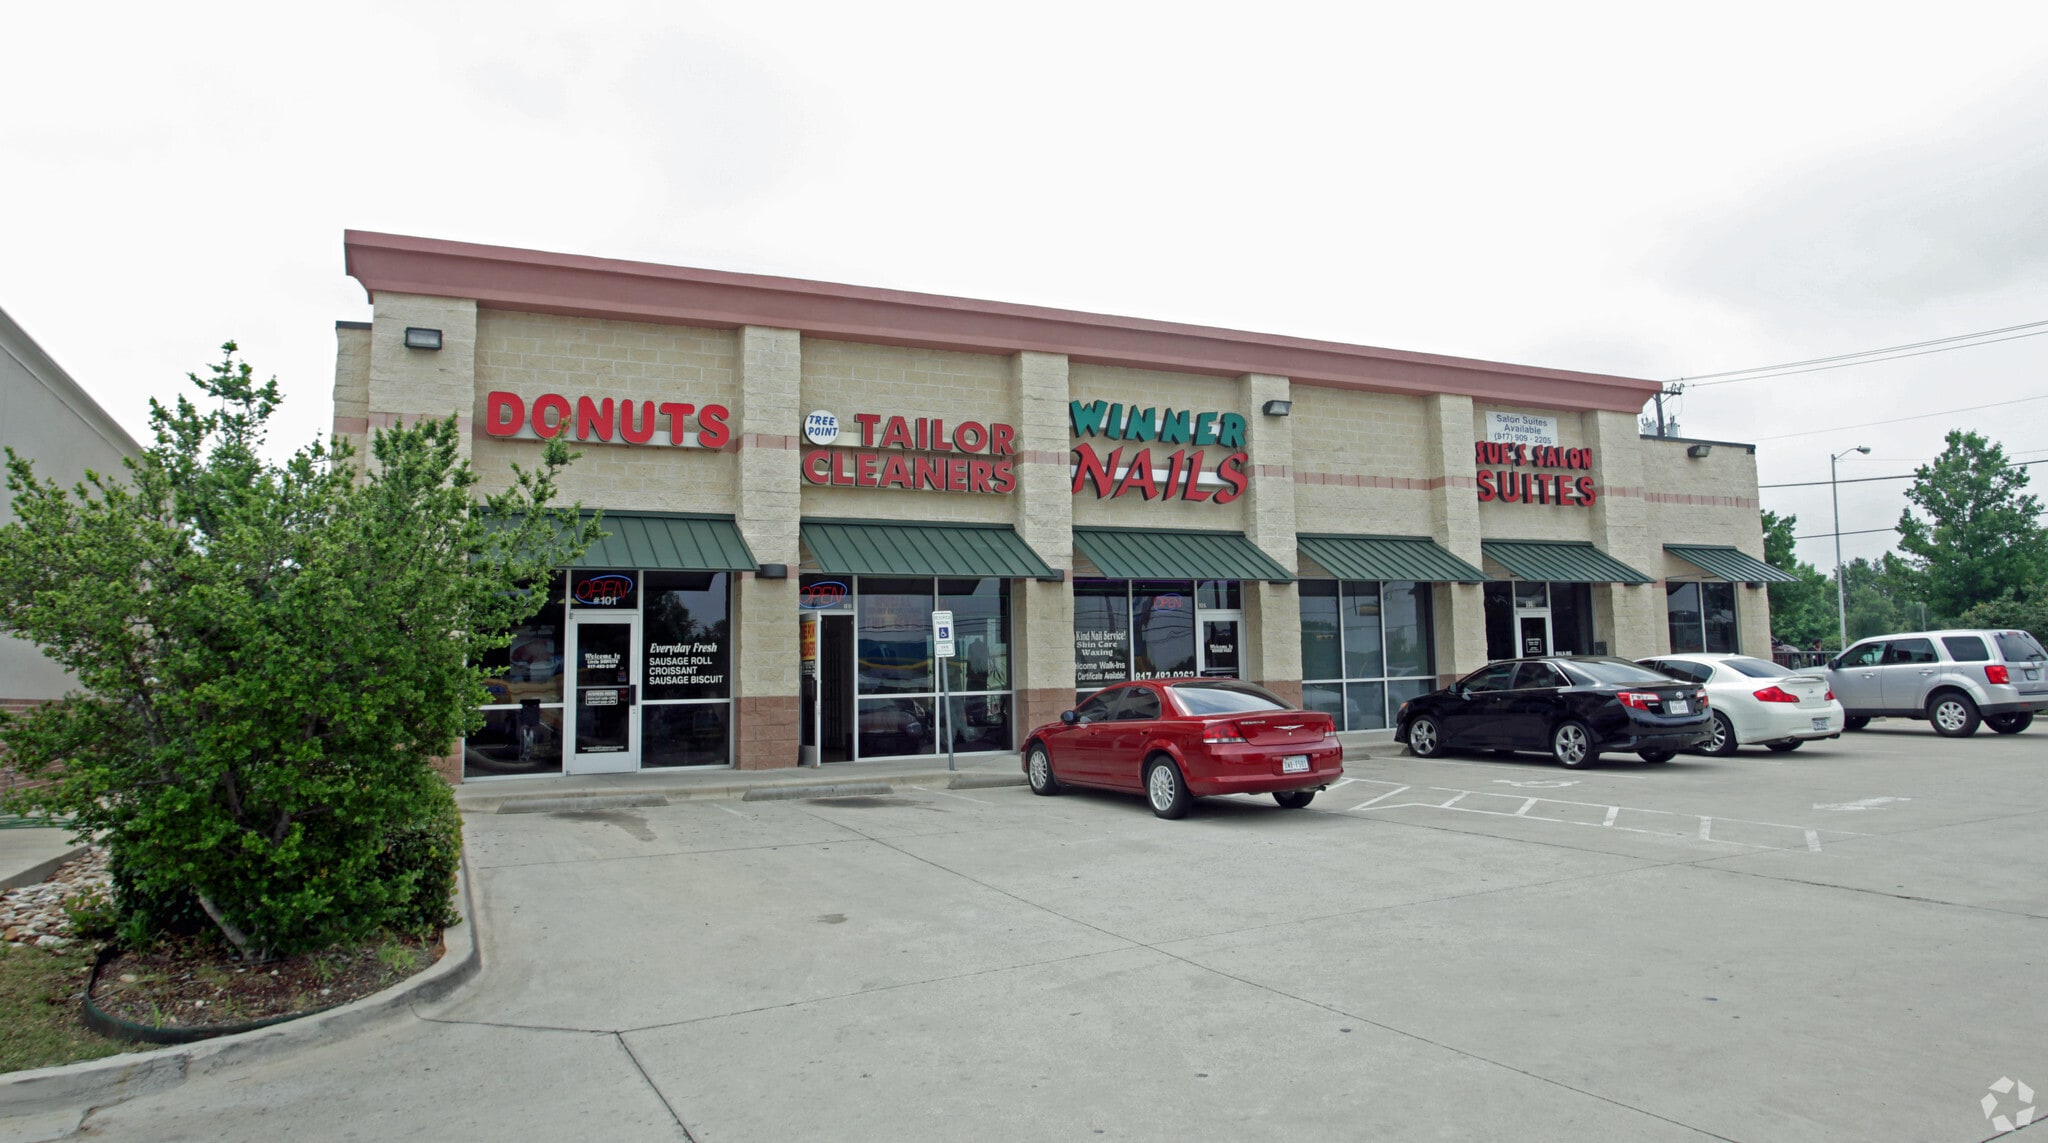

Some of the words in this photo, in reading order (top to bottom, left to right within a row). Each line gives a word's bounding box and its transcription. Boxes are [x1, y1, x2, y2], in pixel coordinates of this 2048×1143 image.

[486, 390, 730, 449] DONUTS
[809, 415, 835, 426] TREE
[1069, 399, 1246, 447] WINNER
[1496, 414, 1520, 424] Salon
[1522, 416, 1548, 427] Suites
[808, 426, 838, 437] POINT
[854, 413, 1015, 456] TAILOR
[1504, 424, 1542, 435] Available
[1515, 433, 1528, 442] 909
[1532, 444, 1593, 470] SALON
[802, 449, 1017, 494] CLEANERS
[1071, 441, 1248, 505] NAILS
[1477, 469, 1597, 507] SUITES
[576, 579, 629, 599] OPEN
[799, 585, 844, 604] OPEN
[593, 596, 617, 606] #101
[1153, 595, 1183, 609] OPEN
[1091, 630, 1102, 641] Nail
[650, 642, 691, 656] Everyday
[692, 642, 718, 653] Fresh
[1081, 648, 1114, 657] Waxing
[649, 657, 689, 666] SAUSAGE
[690, 656, 713, 665] ROLL
[1075, 662, 1097, 670] lcome
[649, 666, 698, 675] CROISSANT
[1077, 671, 1103, 680] Certificate
[649, 676, 689, 685] SAUSAGE
[690, 675, 724, 684] BISCUIT
